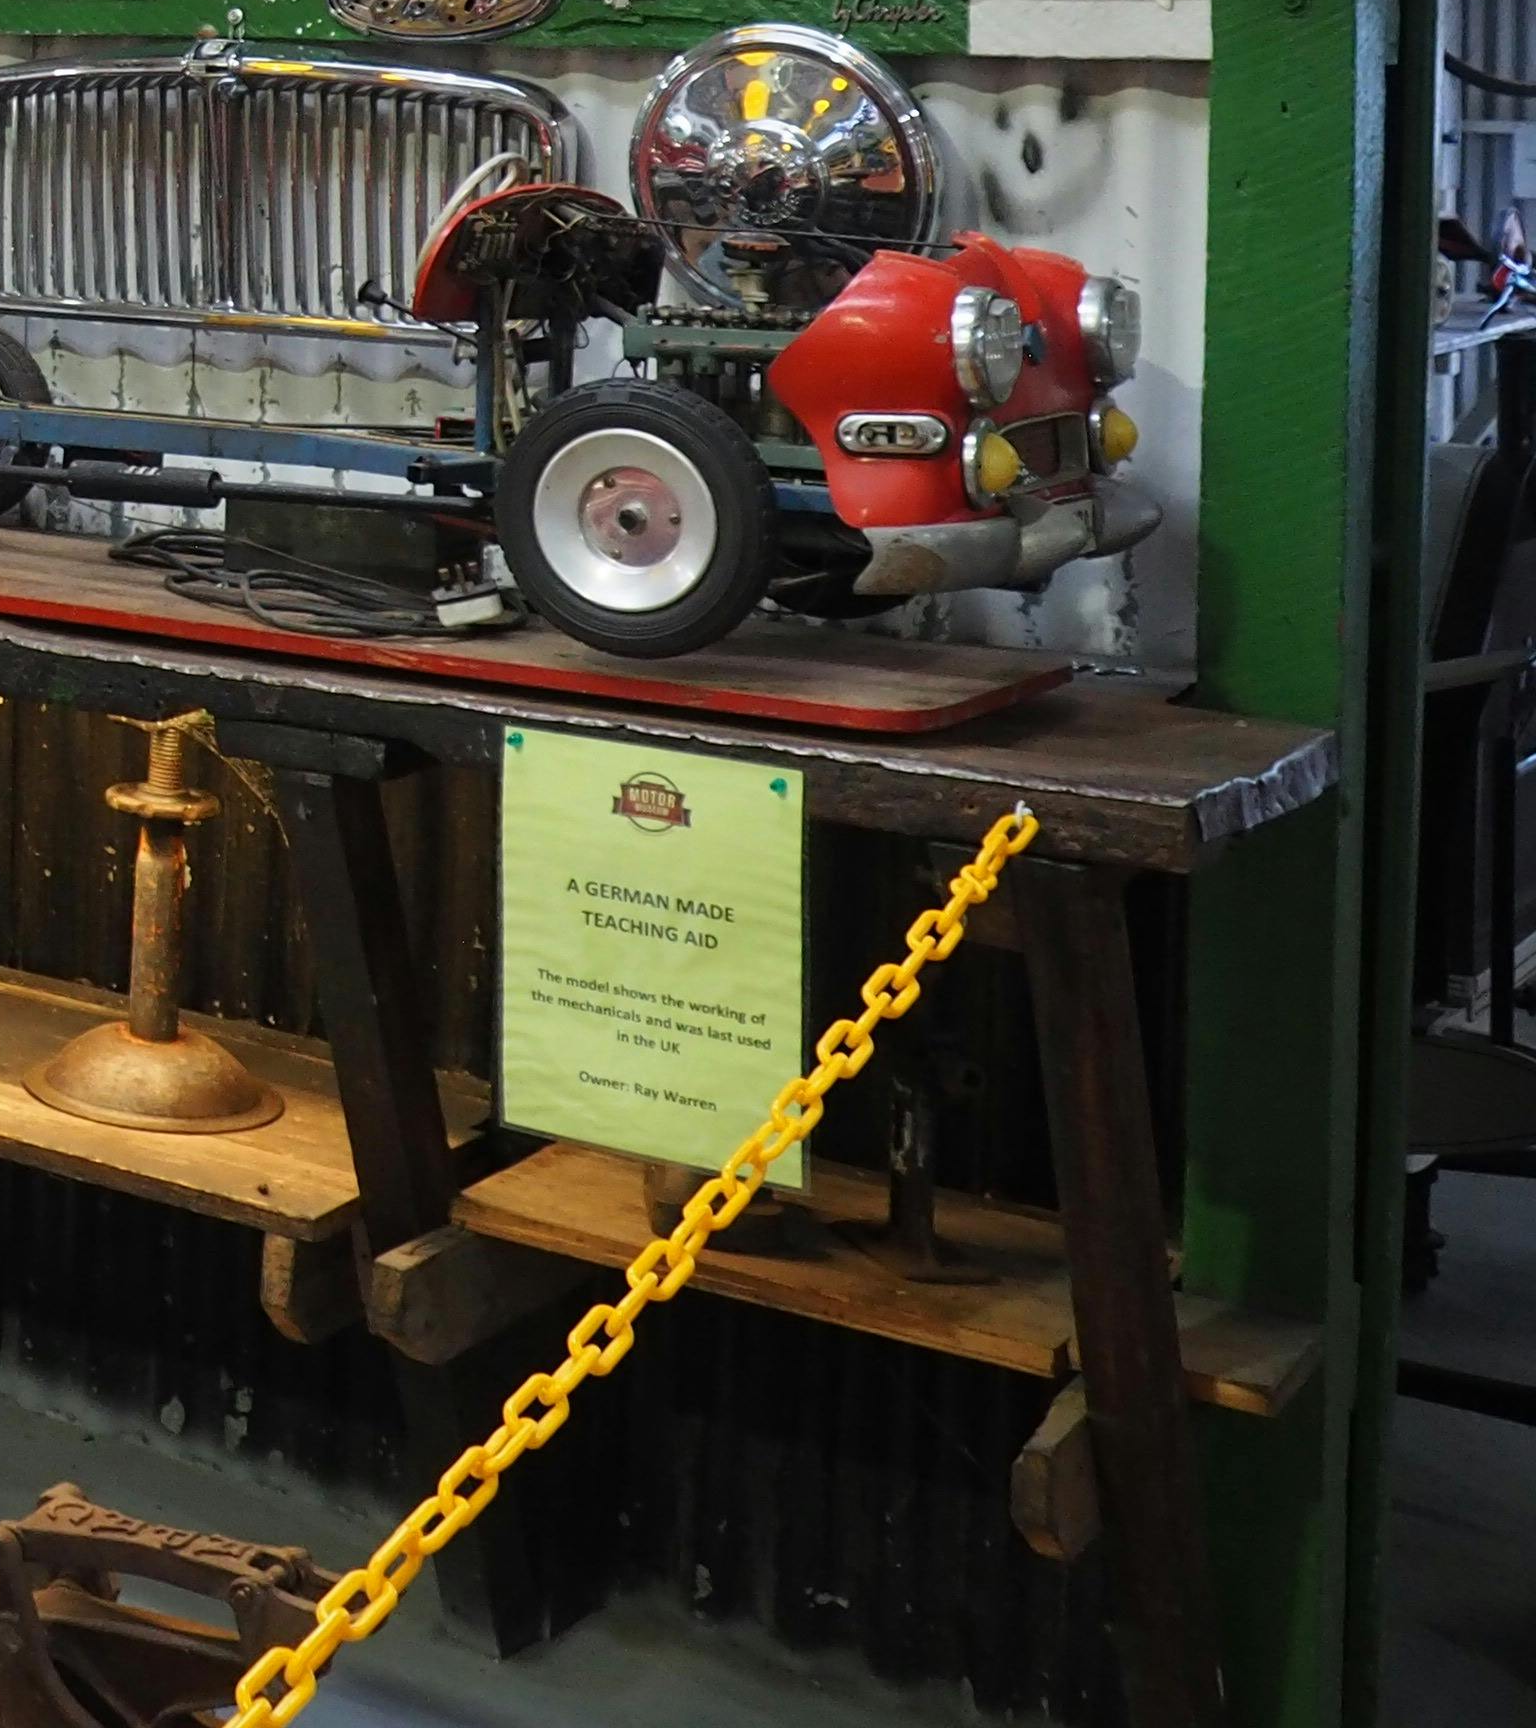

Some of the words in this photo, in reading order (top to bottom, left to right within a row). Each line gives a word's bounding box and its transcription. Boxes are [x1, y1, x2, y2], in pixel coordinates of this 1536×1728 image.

[832, 0, 852, 31] by
[629, 787, 676, 808] MOTOR
[567, 878, 579, 893] A
[585, 881, 669, 910] GERMAN
[677, 898, 735, 922] MADE
[582, 910, 678, 942] TEACHING
[684, 930, 718, 949] AID
[537, 968, 562, 984] The
[566, 975, 609, 993] model
[613, 984, 657, 1003] shows
[661, 994, 684, 1008] the
[689, 1002, 746, 1024] working
[751, 1014, 766, 1025] of
[531, 989, 554, 1004] the
[558, 997, 641, 1022] mechanicals
[646, 1015, 672, 1029] and
[675, 1023, 703, 1036] was
[707, 1026, 733, 1042] last
[737, 1035, 771, 1050] used
[617, 1030, 628, 1042] in
[633, 1034, 656, 1049] the
[661, 1040, 680, 1054] UK
[580, 1071, 629, 1092] Owner:
[634, 1083, 659, 1100] Ray
[663, 1089, 717, 1111] Warren
